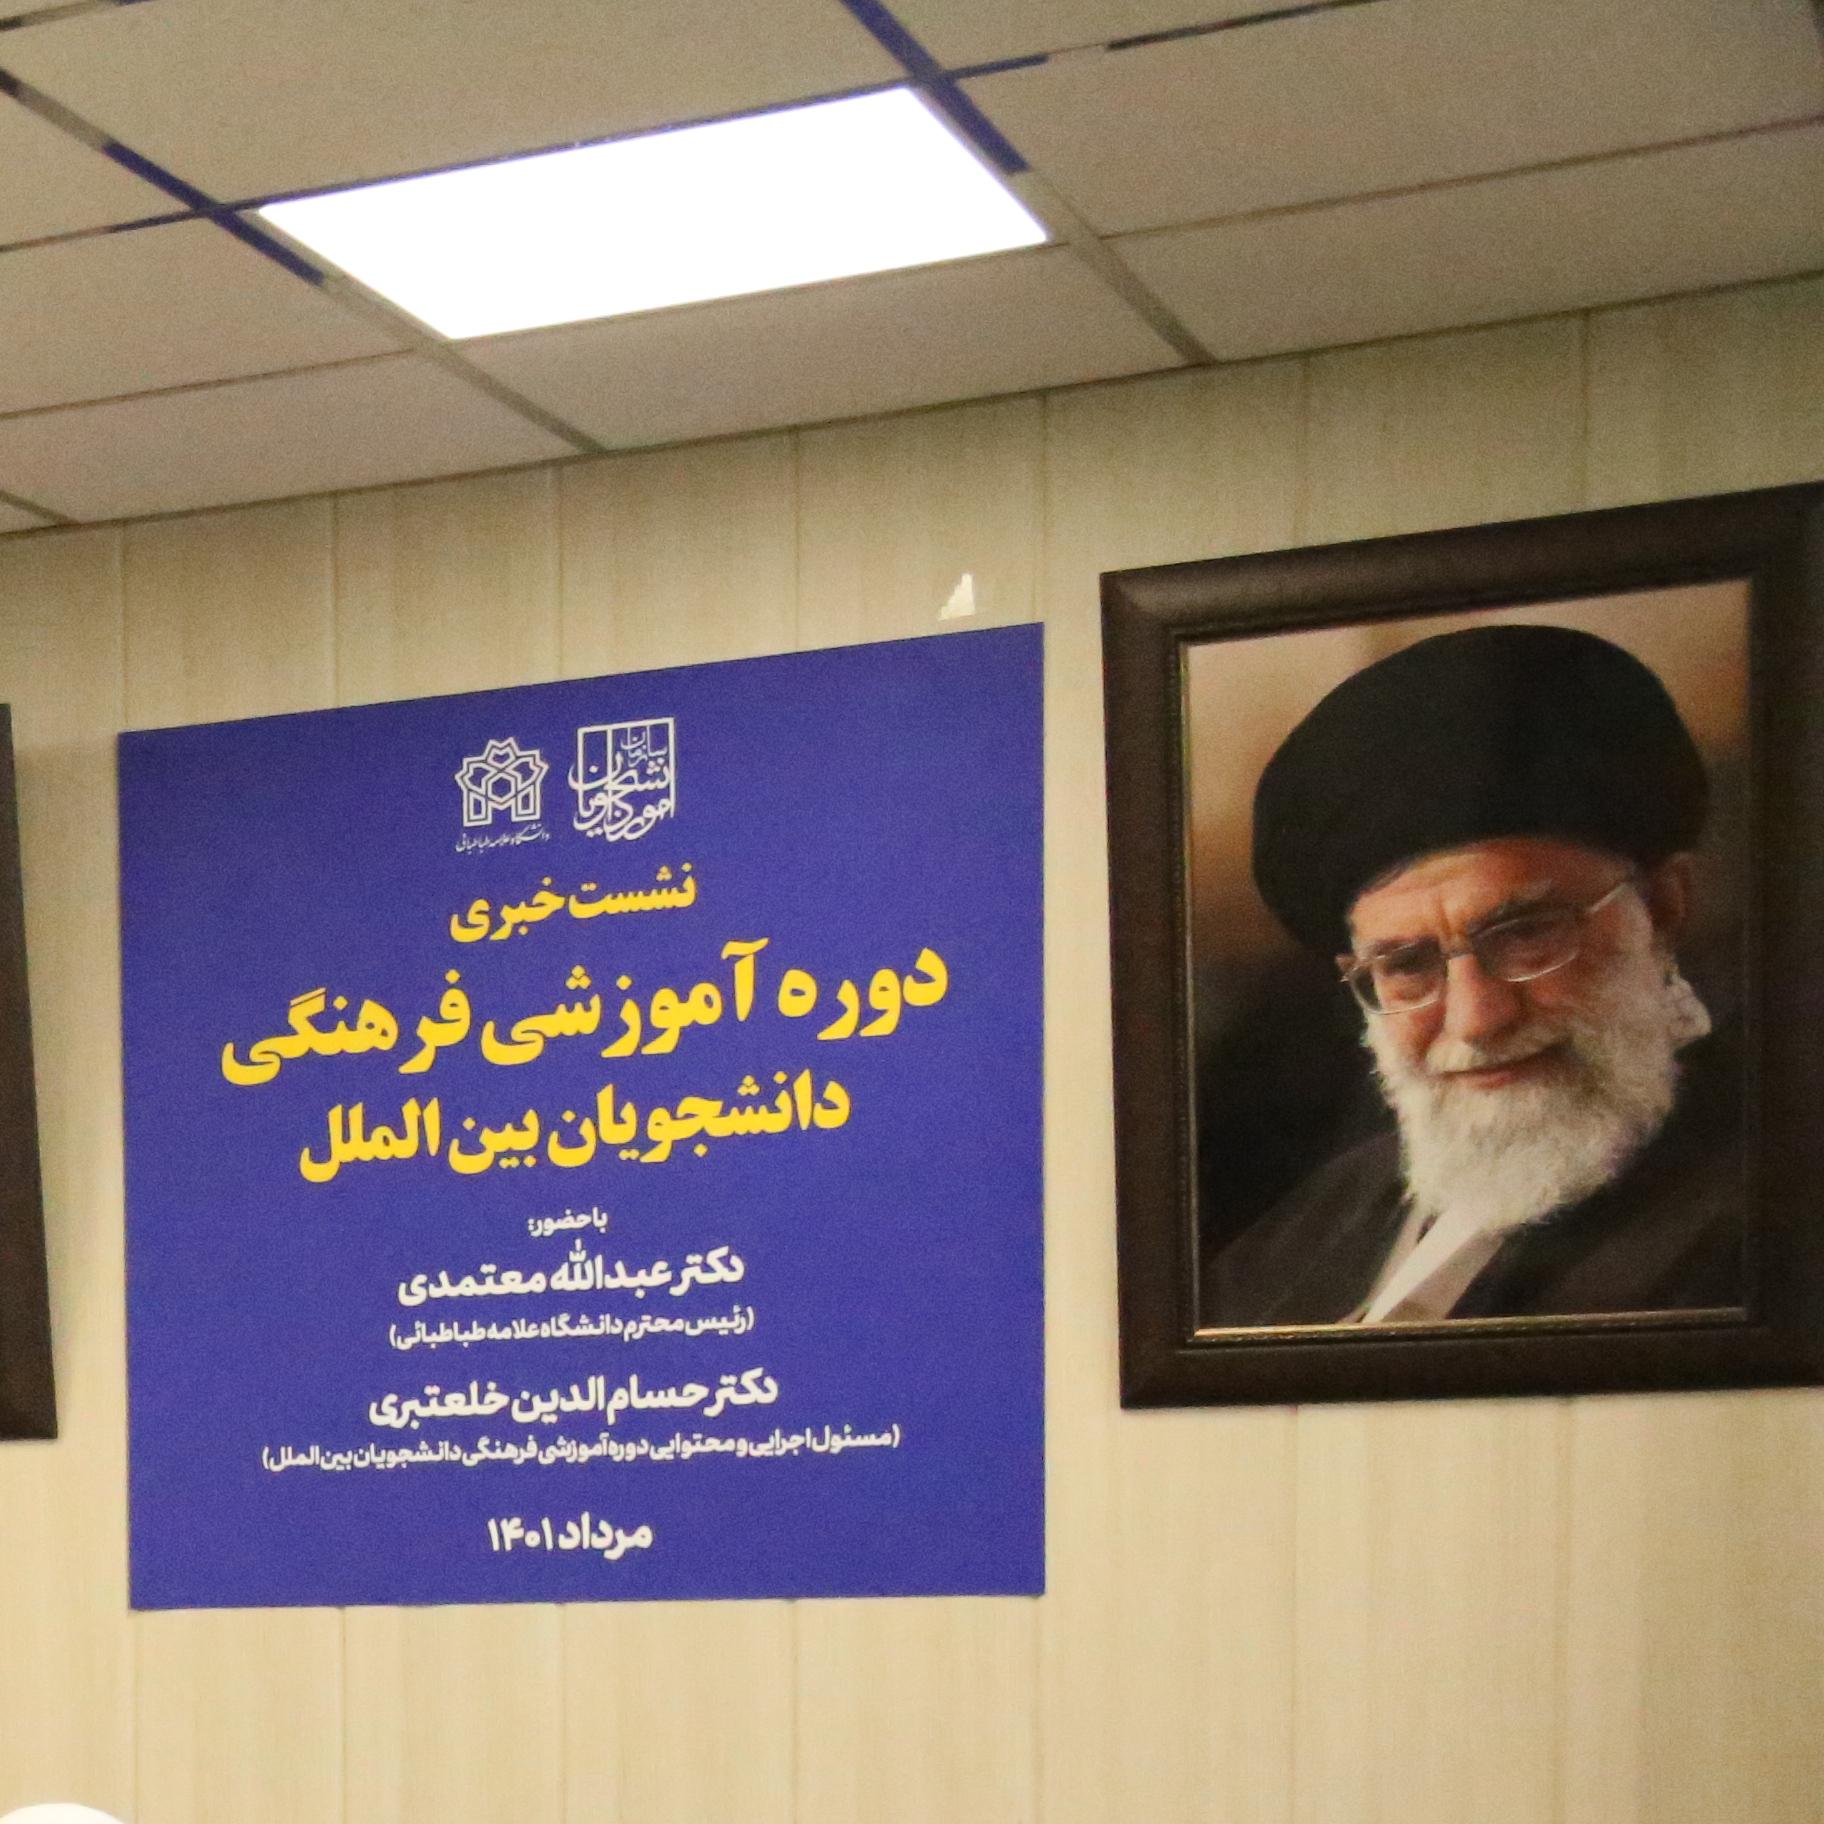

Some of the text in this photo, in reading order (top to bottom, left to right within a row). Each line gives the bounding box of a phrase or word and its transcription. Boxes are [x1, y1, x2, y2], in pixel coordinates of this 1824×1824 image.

[450, 862, 698, 943] نشست خبری
[221, 937, 949, 1086] دوره آموزشی فرهنگی
[299, 1069, 851, 1183] دانشجویان بین الملل
[398, 1238, 745, 1307] دکتر عبدالله معتمدی
[487, 1317, 541, 1341] علامه
[541, 1313, 624, 1338] دانشگاه
[623, 1314, 684, 1342] محترم
[685, 1305, 755, 1336] (رئیس
[369, 1367, 779, 1431] دکتر حسام الدین خلعتبری
[262, 1424, 901, 1473] (مسئول اجرایی و محتوایی دوره آموزشی فرهنگی دانشجویان بین الملل)
[487, 1511, 654, 1561] مرداد ۱۴۰۱
